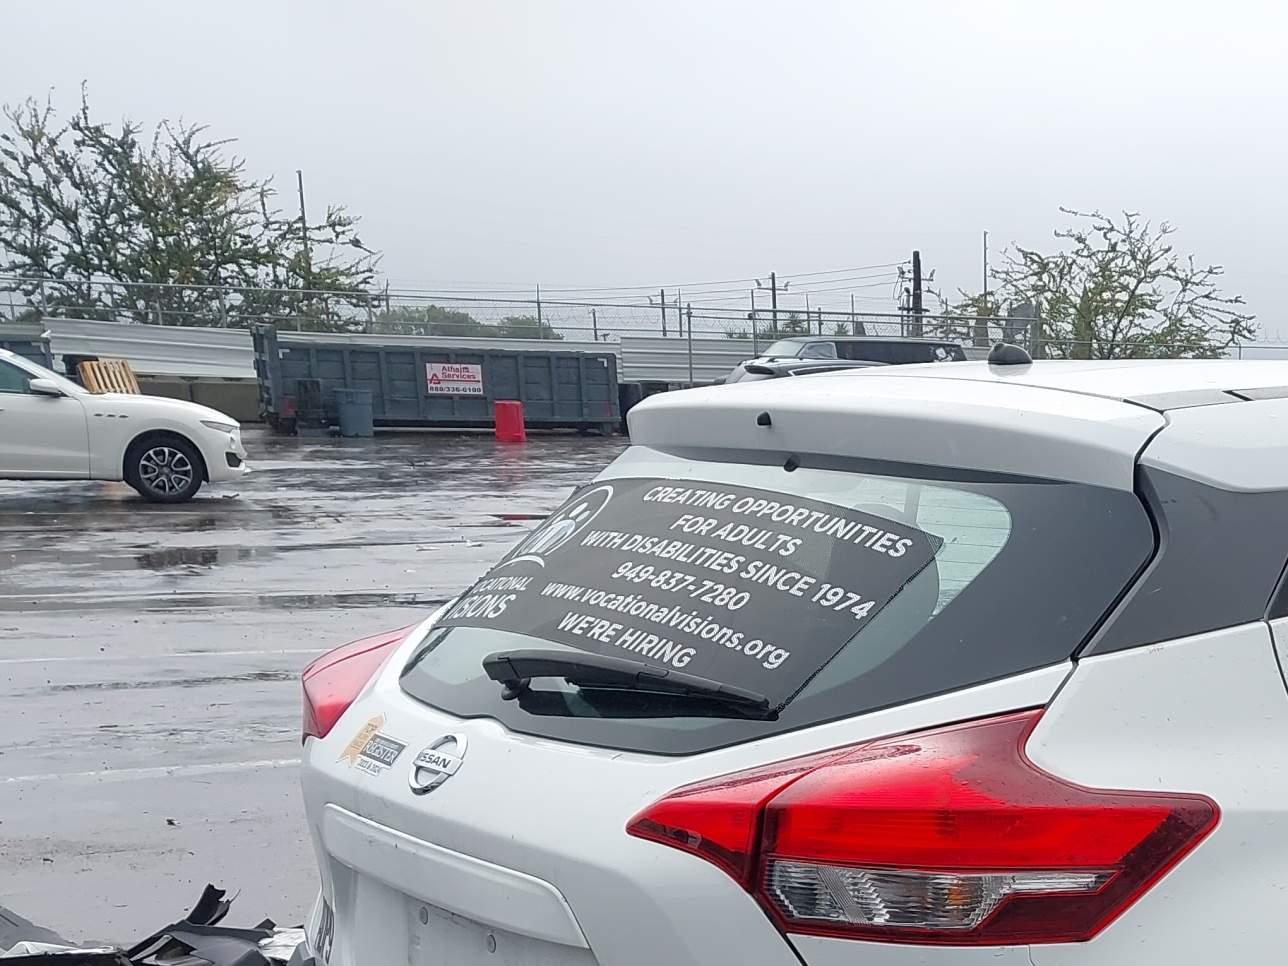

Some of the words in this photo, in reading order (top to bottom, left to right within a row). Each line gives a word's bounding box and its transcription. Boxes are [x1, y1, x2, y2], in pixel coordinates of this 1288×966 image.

[643, 486, 736, 510] CREATING
[732, 497, 913, 558] OPPORTUNITIES
[669, 514, 718, 536] FOR
[710, 522, 803, 557] ADULTS
[580, 530, 630, 549] WITH
[620, 534, 746, 574] DISABILITIES
[739, 560, 817, 597] SINCE
[811, 583, 876, 620] 1974
[611, 561, 751, 611] 949-837-7280
[540, 582, 791, 670] www.vocationalvisions.org
[557, 611, 624, 643] WE'RE
[614, 628, 697, 668] HIRING
